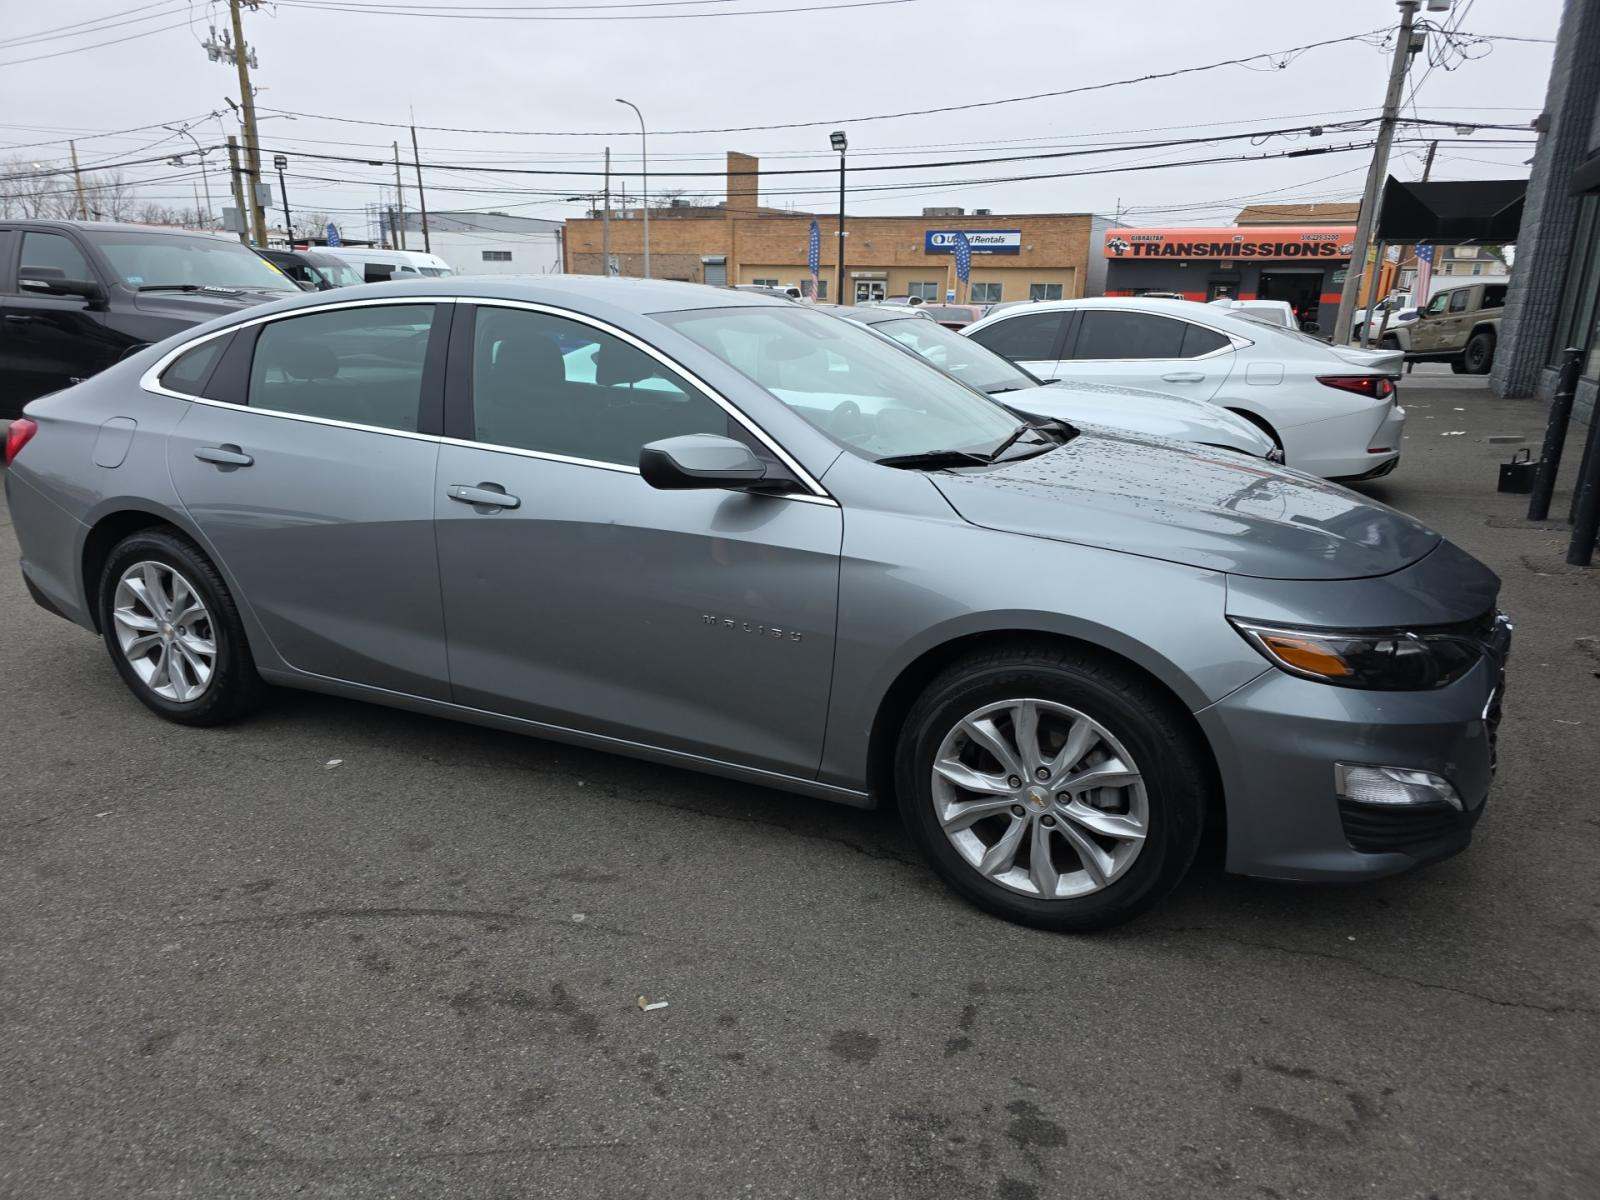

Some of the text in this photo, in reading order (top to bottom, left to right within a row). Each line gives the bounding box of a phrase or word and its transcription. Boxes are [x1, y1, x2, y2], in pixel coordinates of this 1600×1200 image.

[975, 235, 1006, 243] Rentals
[1131, 242, 1336, 256] TRANSMISSIONS
[703, 614, 803, 642] MALIBU
